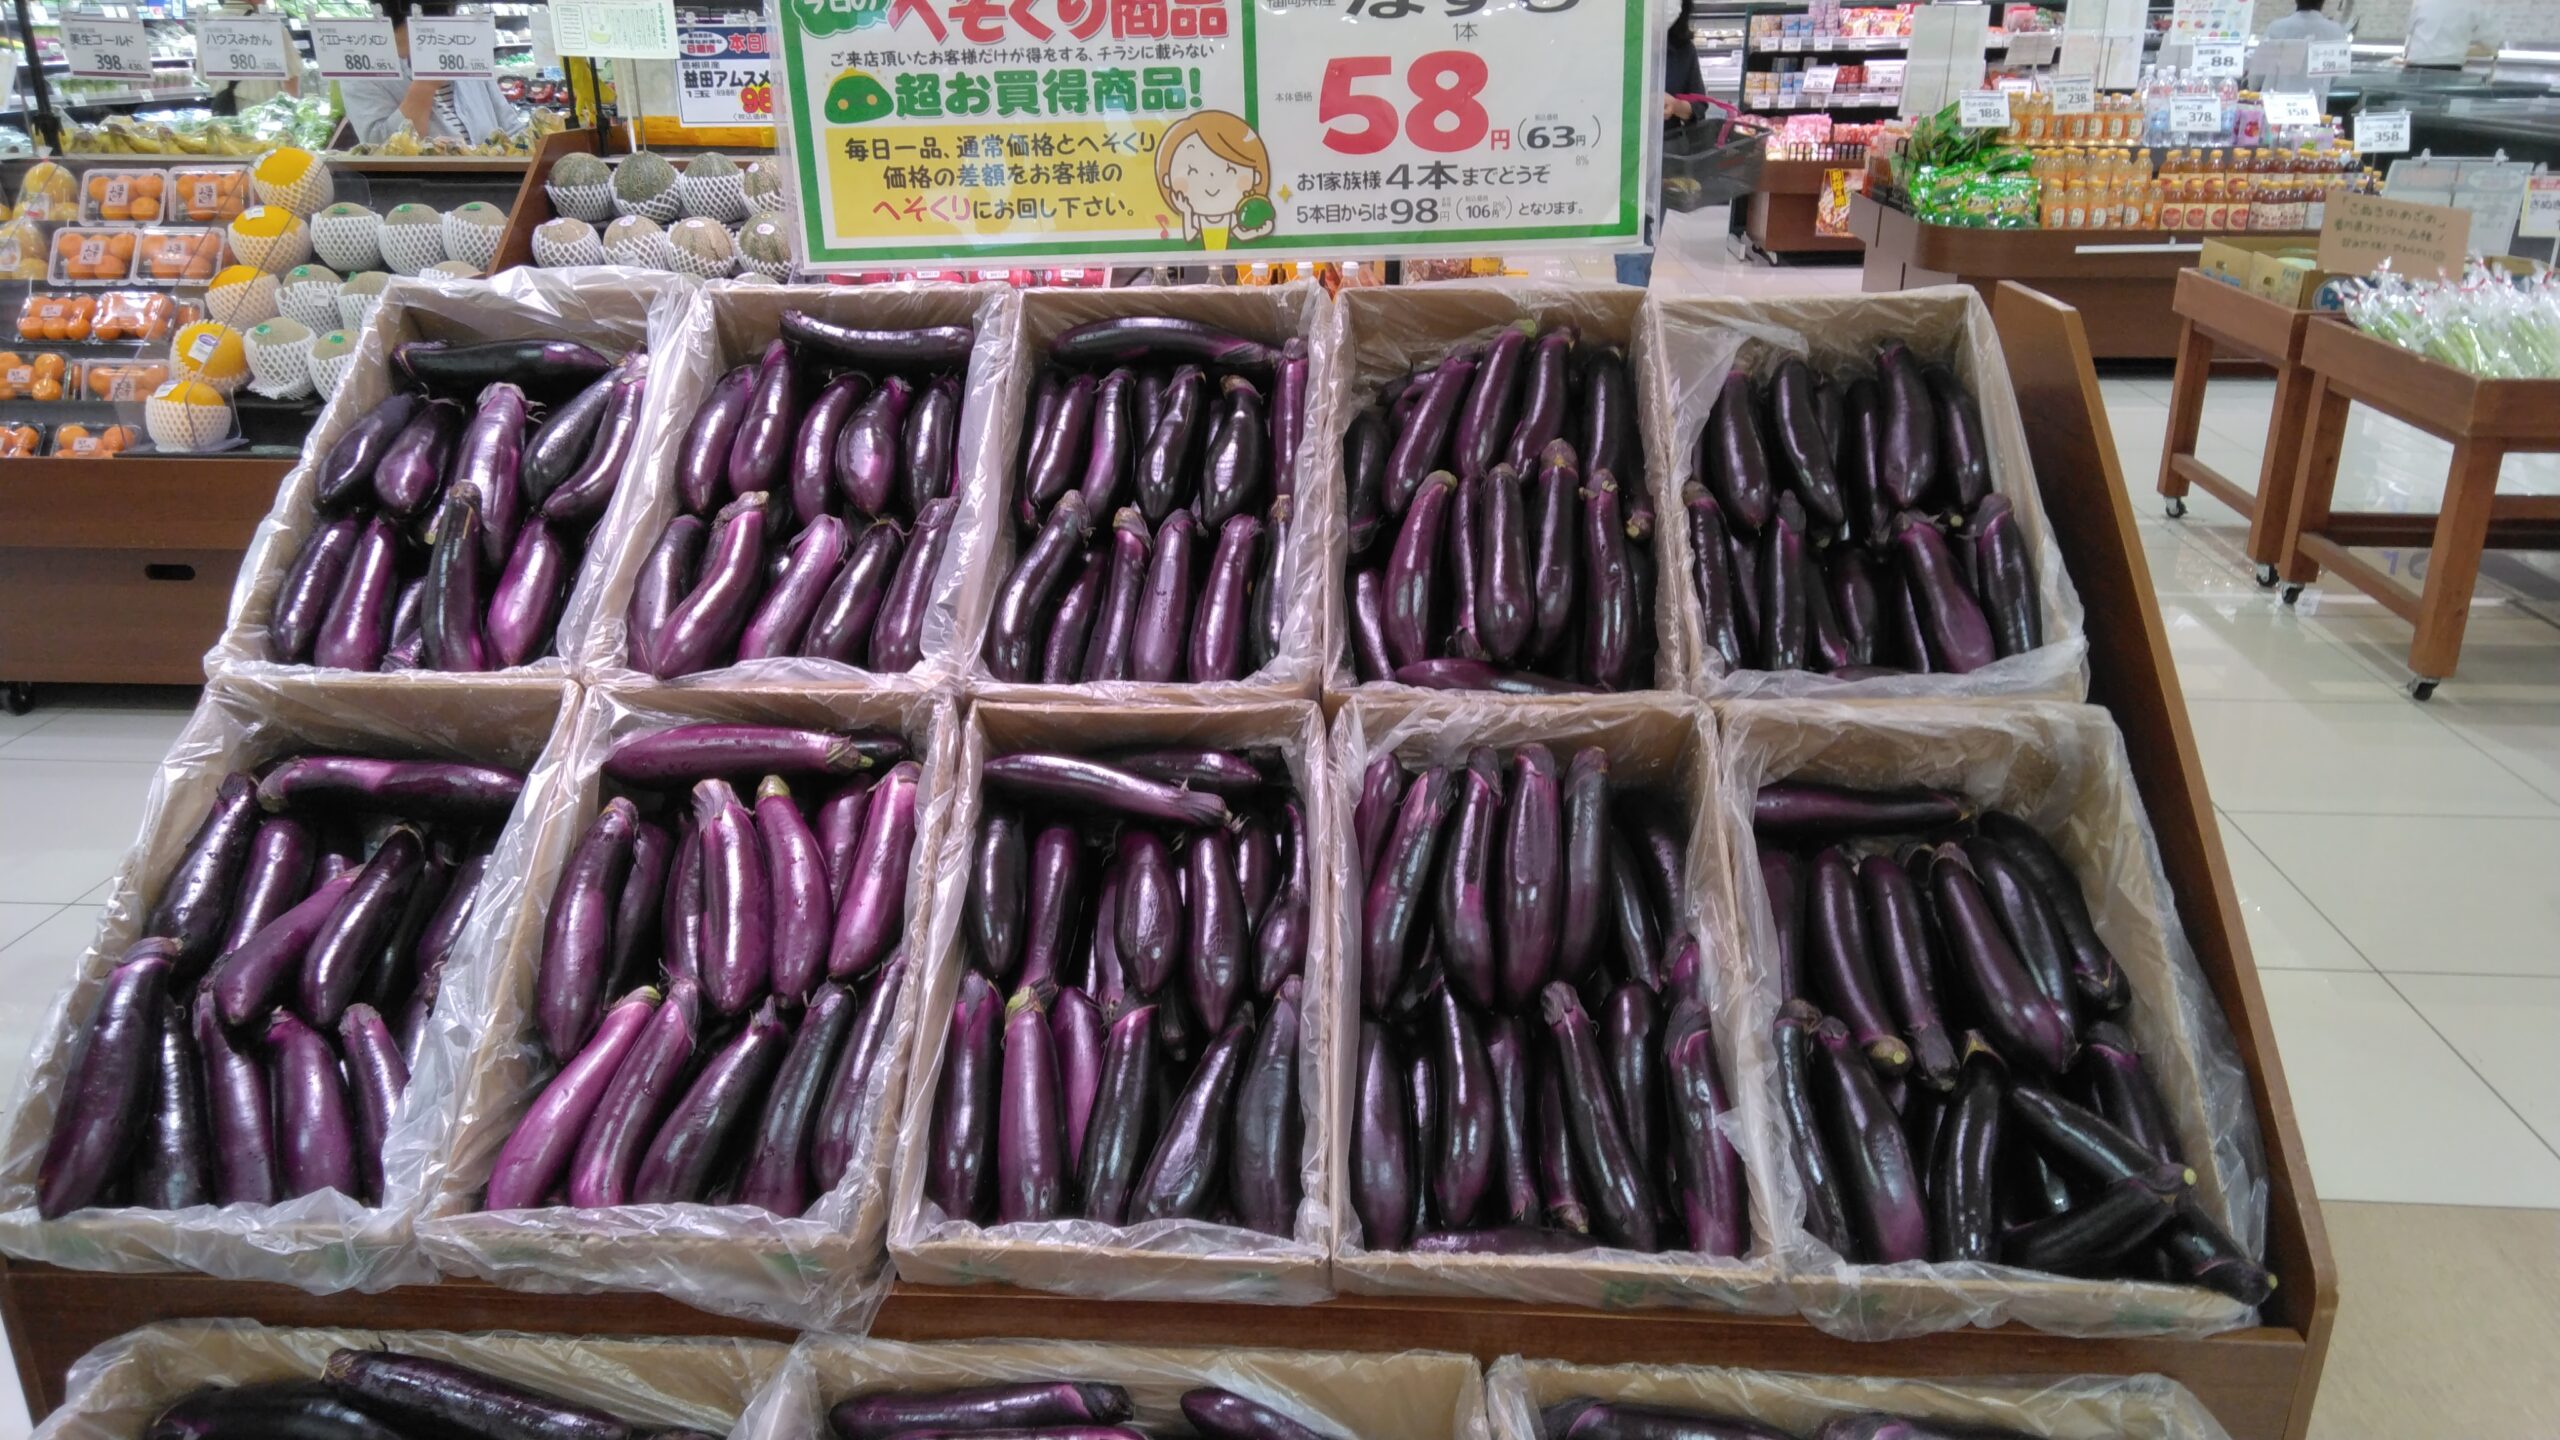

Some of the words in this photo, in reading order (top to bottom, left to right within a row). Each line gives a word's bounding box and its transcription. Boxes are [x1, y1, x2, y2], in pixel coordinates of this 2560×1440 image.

[206, 33, 273, 46] ハウスみかん
[416, 34, 477, 46] タカミメロン
[728, 33, 769, 53] 本日
[883, 160, 1123, 190] 価格の差額をお客様の
